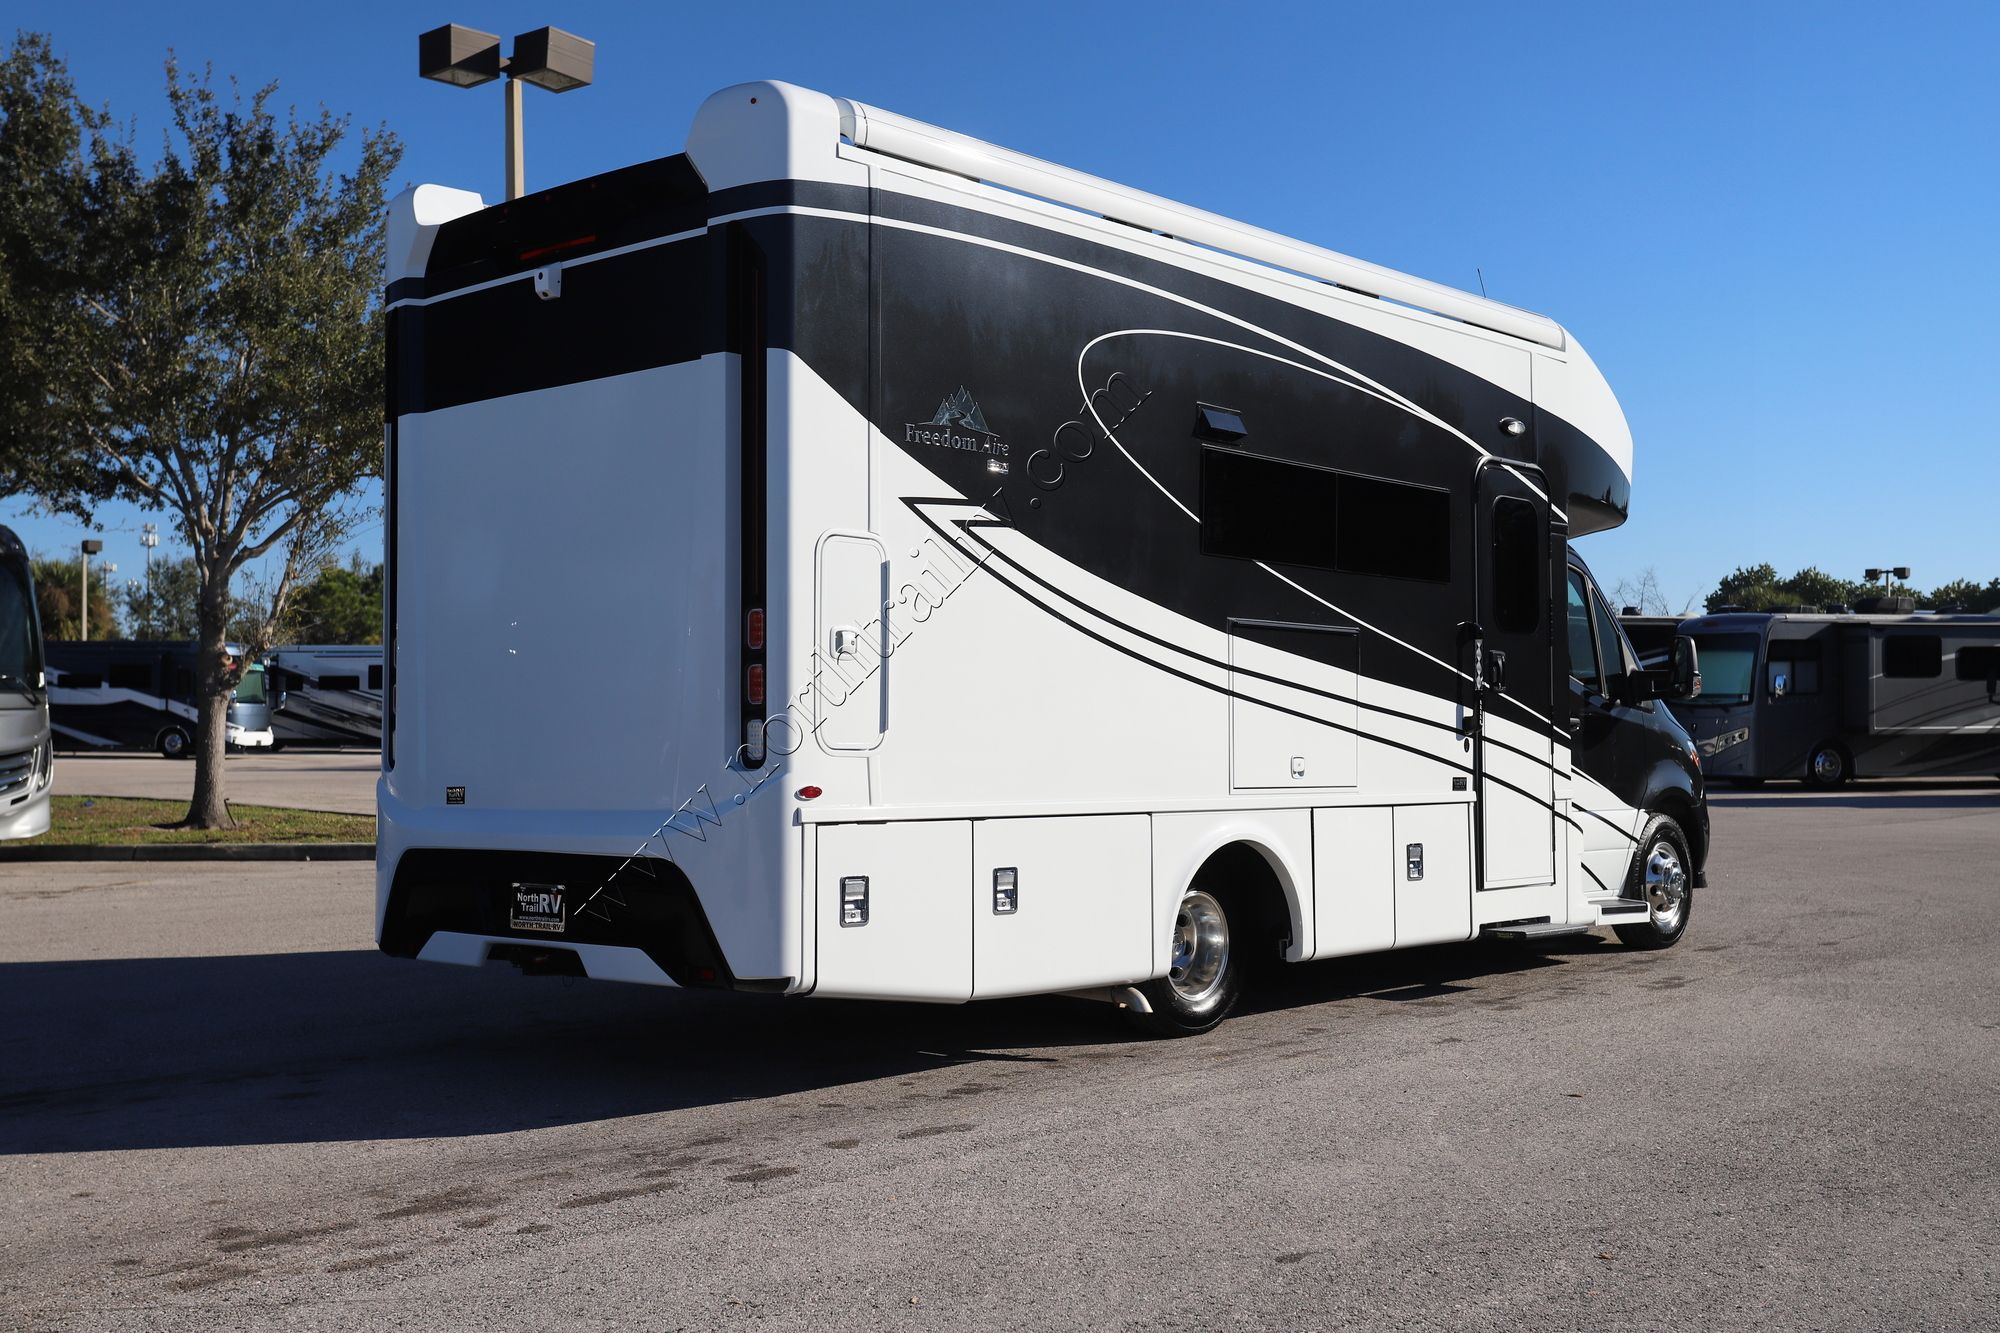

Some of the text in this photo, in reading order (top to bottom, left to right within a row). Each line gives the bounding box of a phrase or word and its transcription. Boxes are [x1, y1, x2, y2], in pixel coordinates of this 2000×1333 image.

[904, 423, 1010, 456] Freedom Aire
[517, 892, 539, 903] North
[539, 893, 562, 914] RV
[521, 902, 539, 913] Trail
